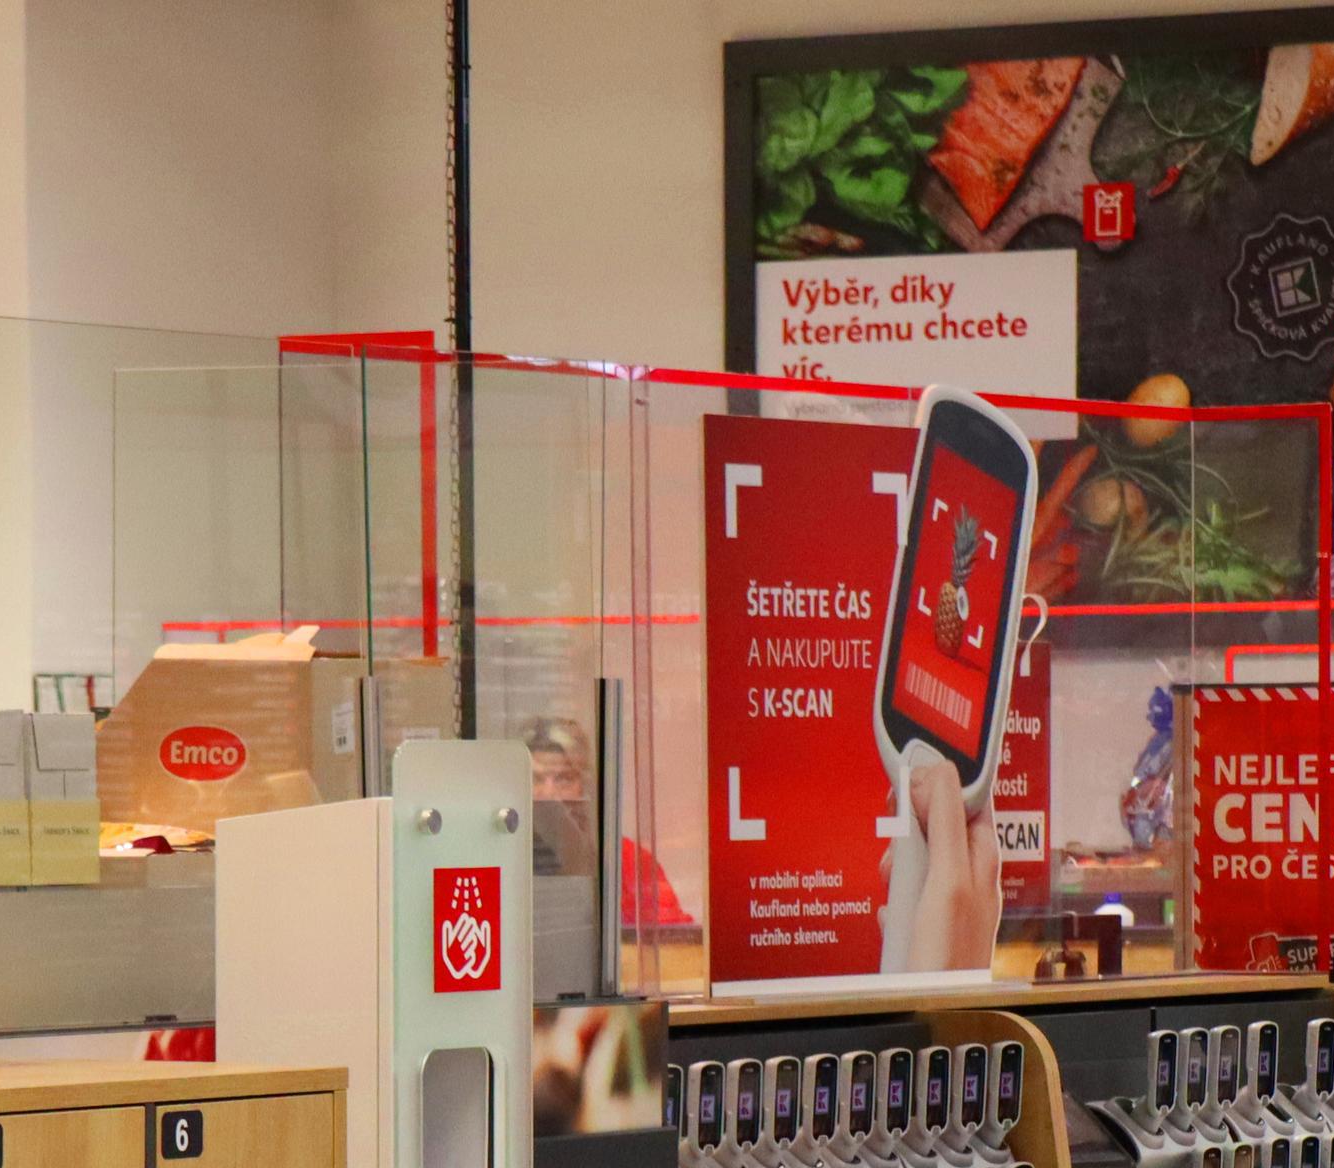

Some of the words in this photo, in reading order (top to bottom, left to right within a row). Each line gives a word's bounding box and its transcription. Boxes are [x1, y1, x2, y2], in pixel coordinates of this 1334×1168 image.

[782, 276, 880, 309] Výběr,
[890, 275, 954, 309] díky
[782, 314, 915, 346] kterému
[923, 311, 1027, 340] chcete
[747, 580, 827, 618] ŠETŘETE
[834, 581, 871, 620] ČAS
[748, 637, 762, 665] A
[767, 639, 872, 670] NAKUPUJTE
[748, 690, 759, 718] S
[764, 689, 833, 718] K-SCAN
[1005, 710, 1041, 741] ákup
[171, 740, 239, 767] Emco
[1213, 855, 1272, 879] PRO
[750, 877, 756, 889] v
[801, 870, 843, 895] aplikaci
[750, 898, 800, 918] Kaufland
[803, 898, 829, 917] nebo
[750, 927, 791, 947] ručního
[794, 926, 838, 944] skeneru.
[175, 1118, 189, 1152] 6
